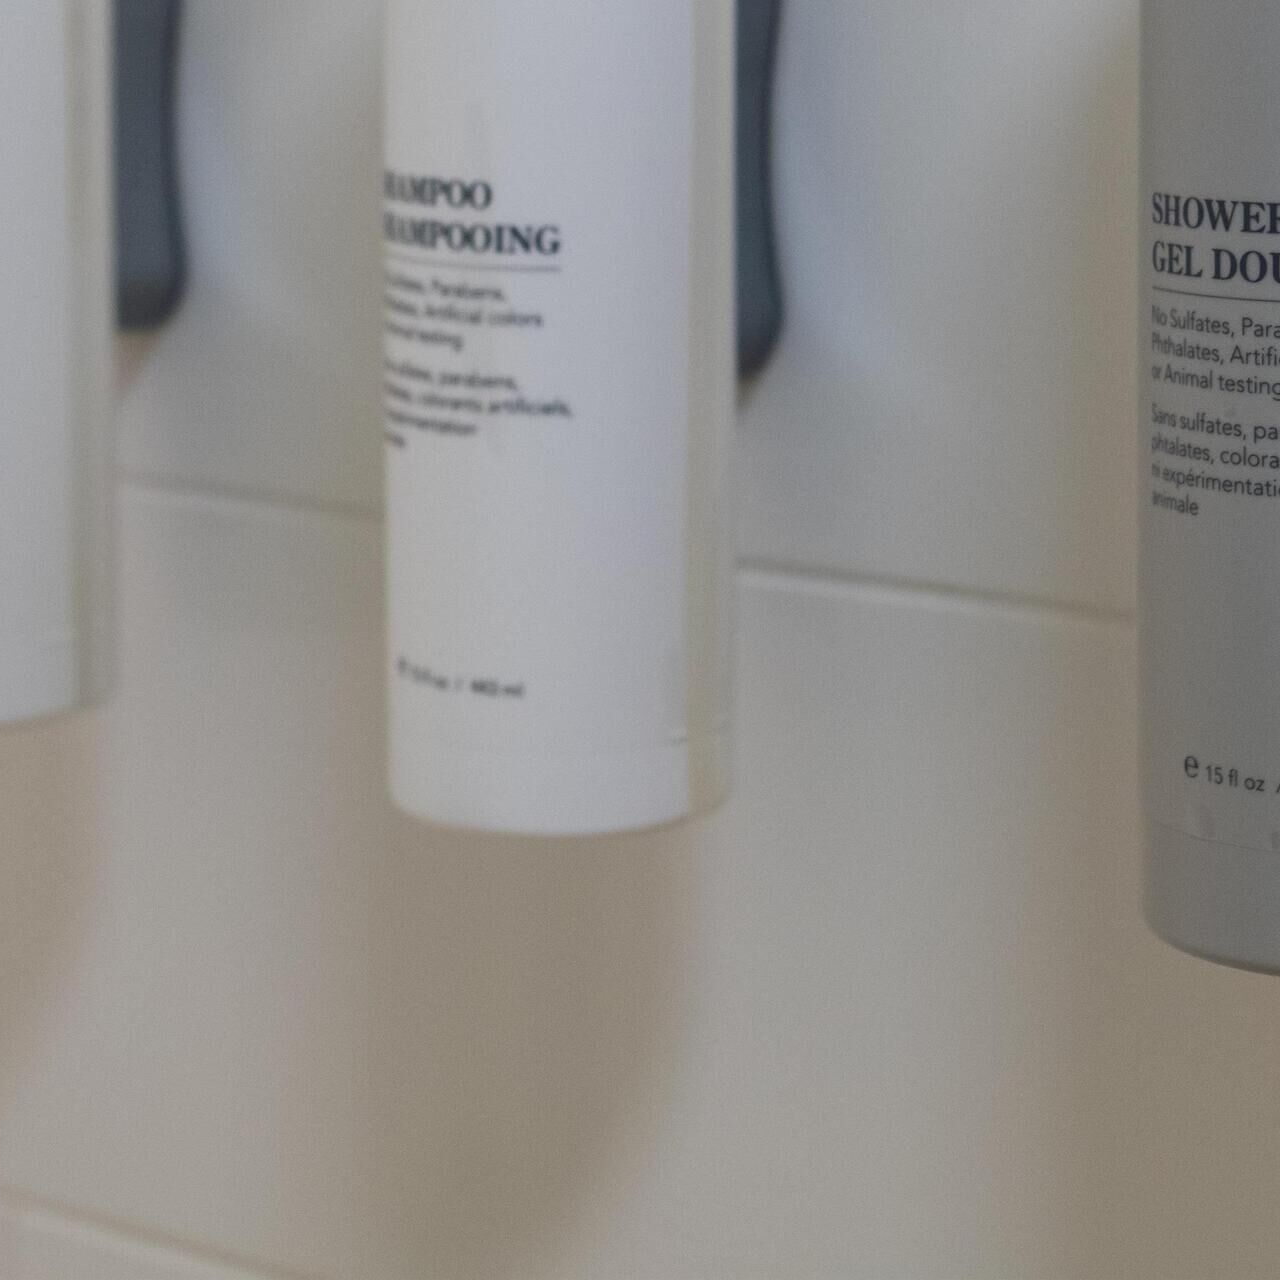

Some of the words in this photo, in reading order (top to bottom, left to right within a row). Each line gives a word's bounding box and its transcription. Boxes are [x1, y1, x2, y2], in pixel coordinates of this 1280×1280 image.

[384, 172, 493, 209] AMPOO
[384, 213, 561, 255] AMPOOING
[1152, 240, 1203, 278] GEL
[1170, 308, 1234, 338] Sulfates,
[1163, 364, 1213, 389] Animal
[1179, 412, 1247, 440] sulfates,
[1206, 765, 1223, 785] 15
[1228, 768, 1238, 787] fl
[1244, 776, 1265, 792] oz
